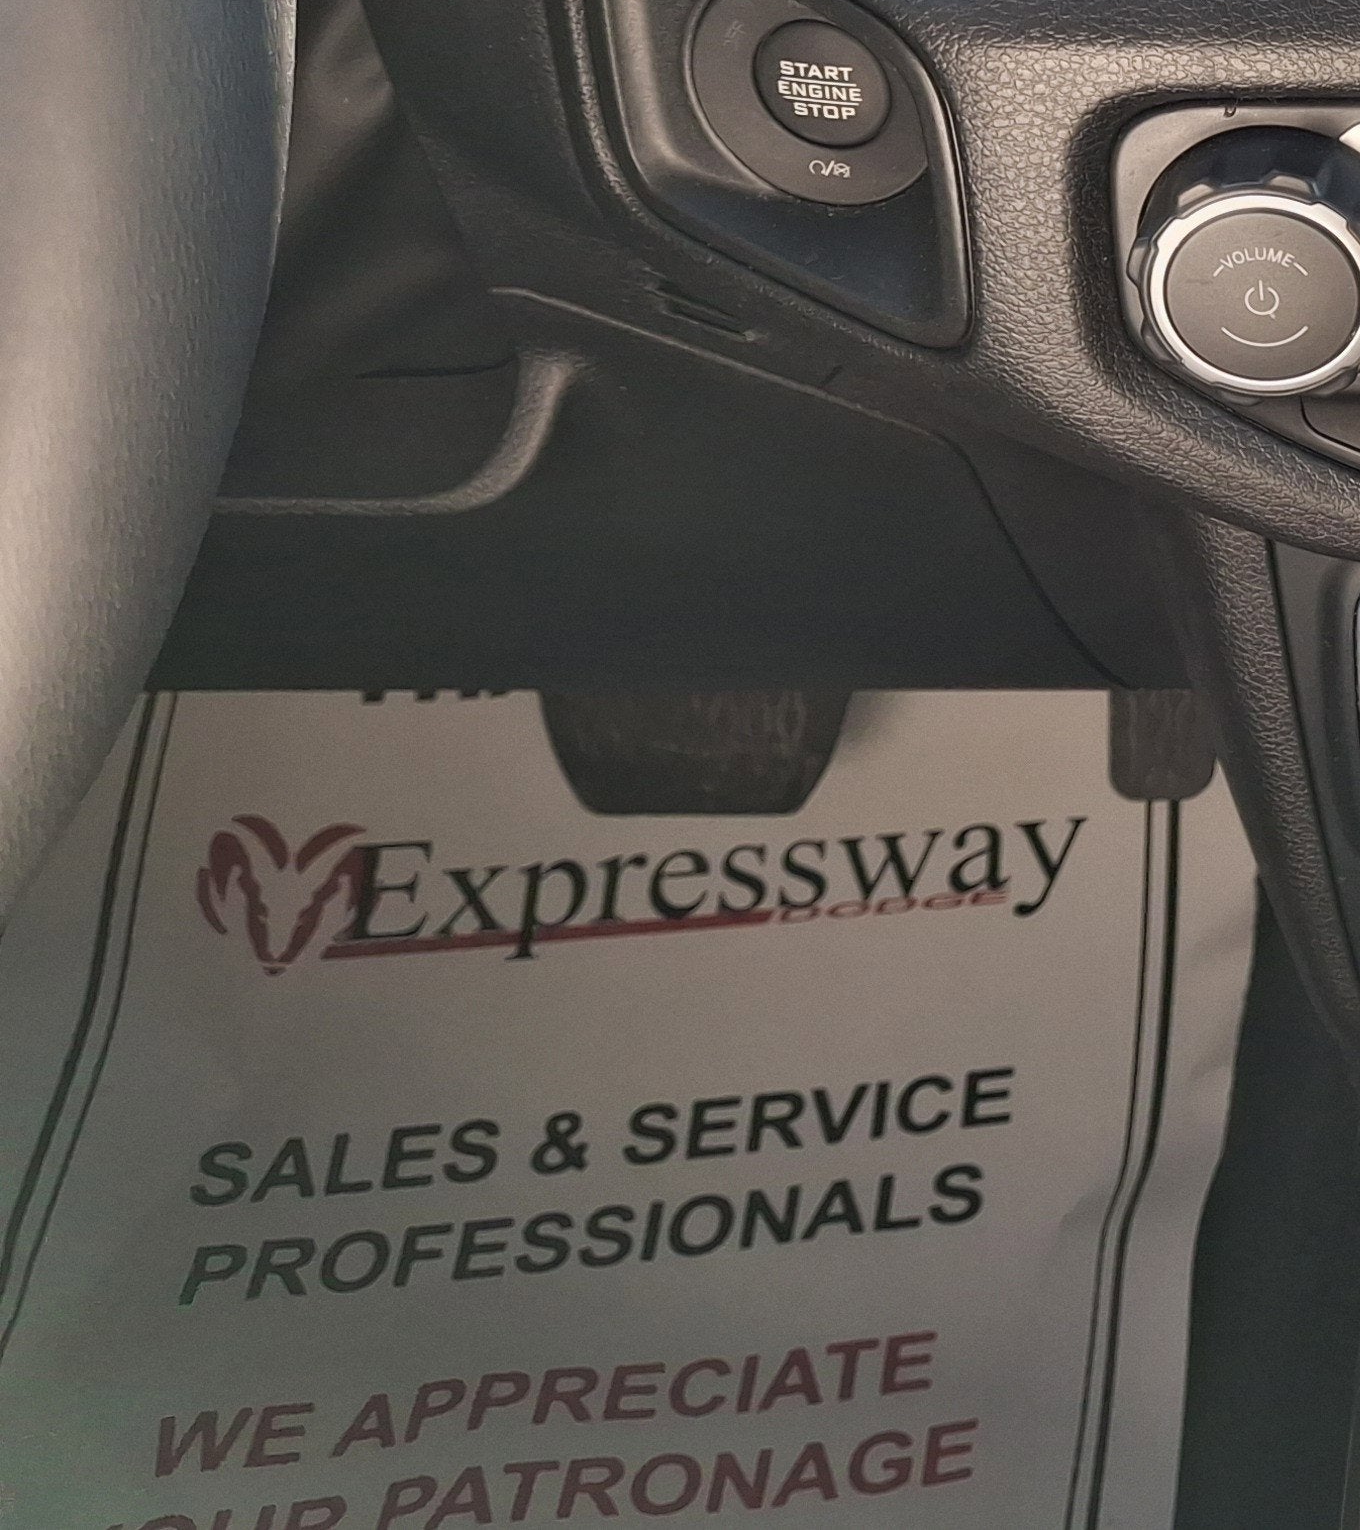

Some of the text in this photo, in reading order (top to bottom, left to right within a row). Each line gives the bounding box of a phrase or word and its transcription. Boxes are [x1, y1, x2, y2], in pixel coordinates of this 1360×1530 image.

[777, 80, 863, 102] ENGINE
[779, 59, 853, 82] START
[793, 101, 856, 120] STOP
[1219, 246, 1295, 269] VOLUME
[333, 816, 1089, 961] Expressway
[773, 888, 1009, 924] DODGE
[188, 1065, 1017, 1210] SALES & SERVICE
[178, 1162, 985, 1307] PROFESSIONALS
[154, 1330, 938, 1478] WE APPRECIATE
[374, 1418, 981, 1530] PATRONAGE
